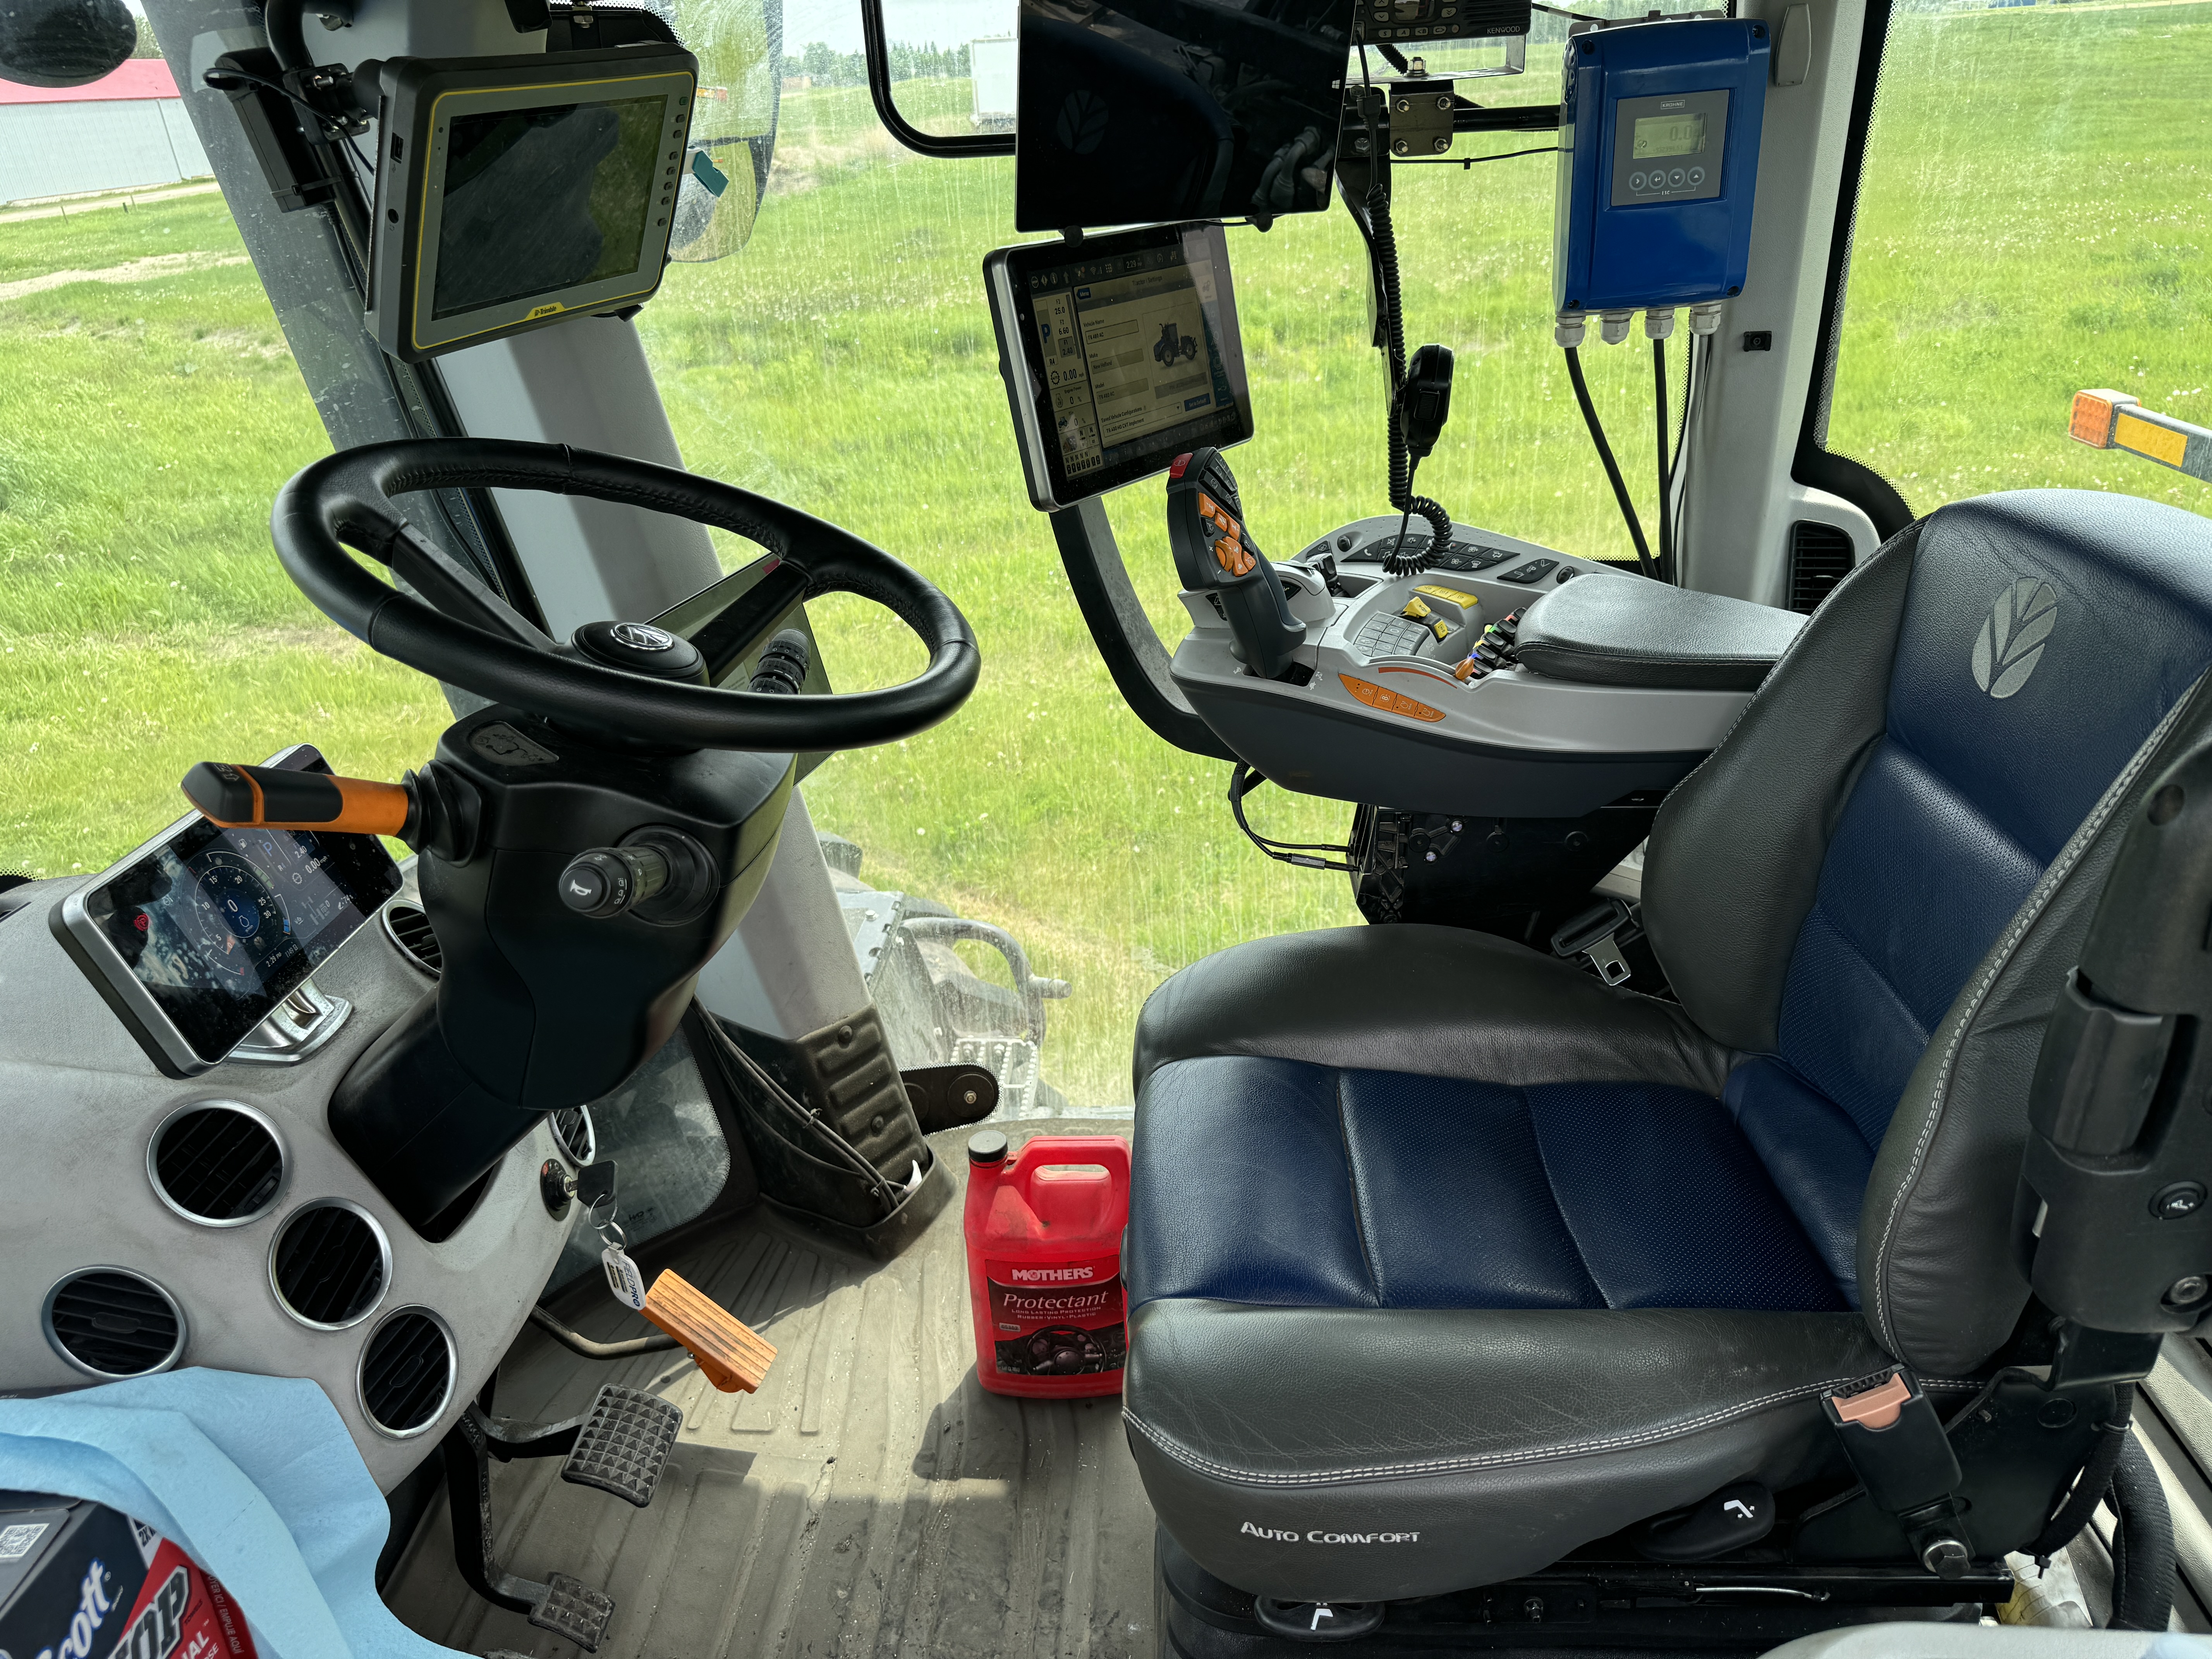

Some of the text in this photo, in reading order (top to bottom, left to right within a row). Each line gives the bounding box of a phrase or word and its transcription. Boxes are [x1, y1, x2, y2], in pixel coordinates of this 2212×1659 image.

[1487, 26, 1520, 34] KENWOOD
[1669, 125, 1692, 141] 0.0
[540, 306, 557, 315] Trimble
[1054, 307, 1065, 315] 25.0
[1041, 323, 1051, 344] P
[1062, 347, 1073, 356] 2.40
[1100, 360, 1113, 368] Holland
[1063, 368, 1077, 381] 0.00
[1070, 396, 1073, 405] 0
[1121, 407, 1142, 417] Configurations
[1074, 418, 1078, 426] 0
[1128, 417, 1144, 427] Implement
[263, 842, 273, 857] P
[295, 845, 307, 859] 2.40
[277, 862, 286, 871] R4
[305, 857, 321, 874] 0.00
[209, 876, 218, 885] 15
[235, 875, 243, 884] 20
[201, 902, 210, 910] 10
[227, 899, 238, 912] 0
[258, 897, 266, 906] 25
[263, 910, 271, 919] 30
[1012, 1266, 1094, 1281] MOTHERS
[622, 1260, 640, 1307] FIELDPRO
[1003, 1290, 1109, 1309] Protectant
[1060, 1306, 1101, 1314] PROTECTION
[1240, 1521, 1420, 1545] AUTO COMFORT
[214, 1594, 225, 1603] ICI
[220, 1608, 236, 1636] EMPUJE
[229, 1636, 245, 1655] AQUÍ
